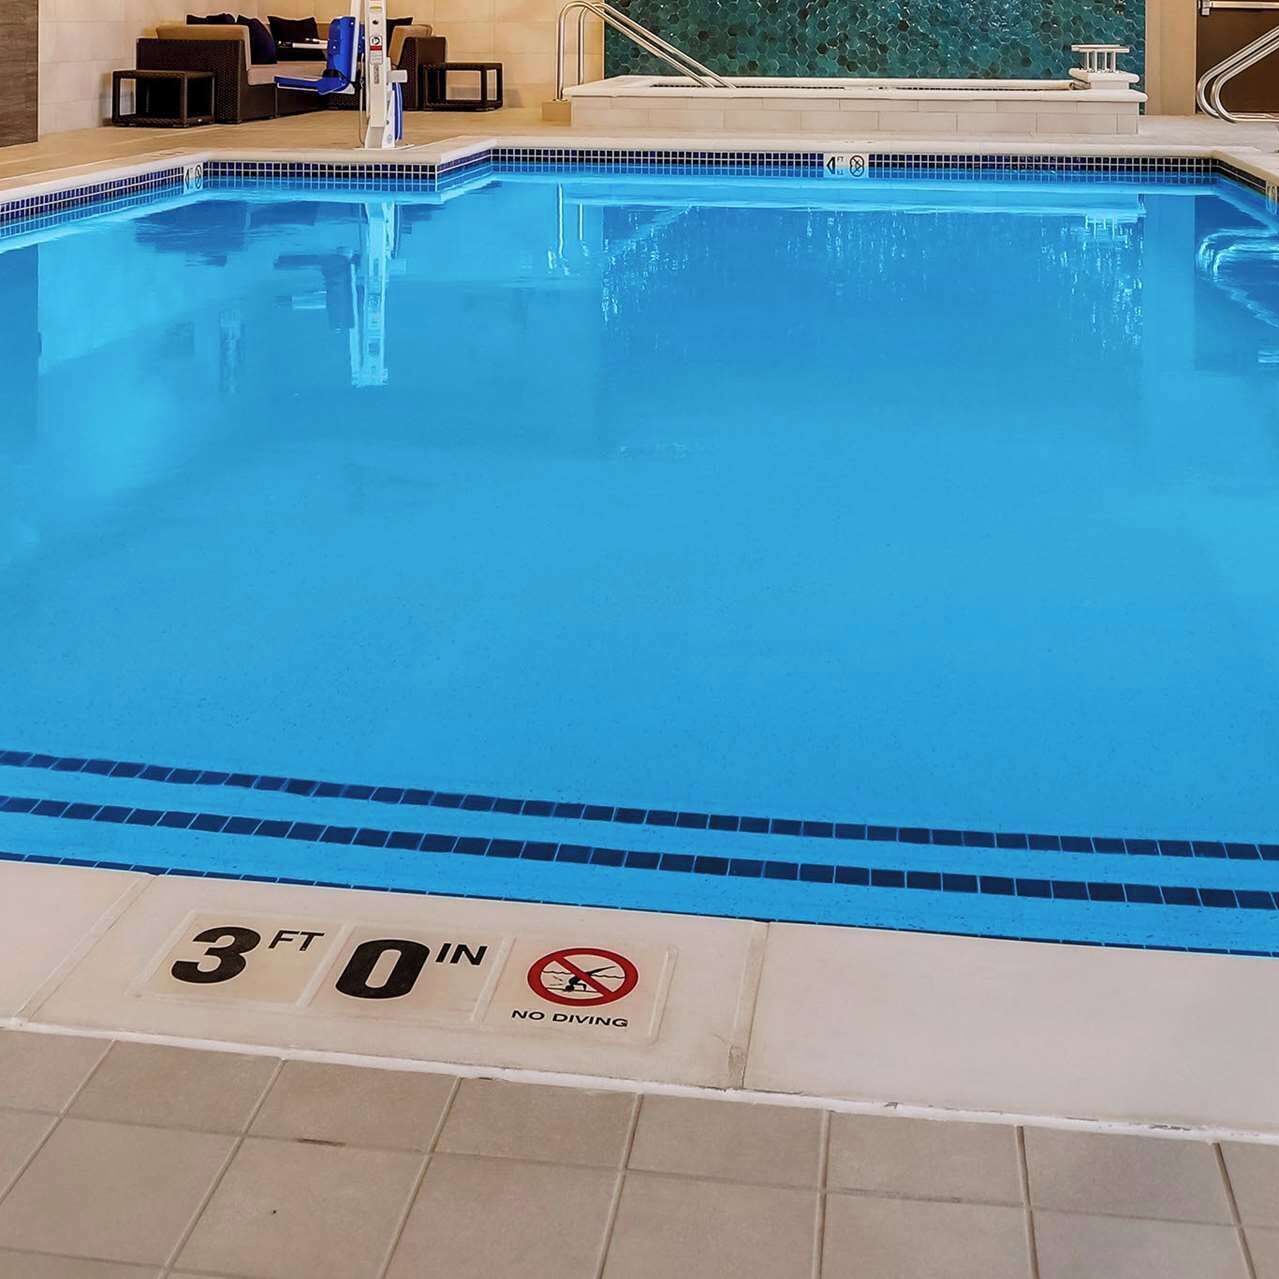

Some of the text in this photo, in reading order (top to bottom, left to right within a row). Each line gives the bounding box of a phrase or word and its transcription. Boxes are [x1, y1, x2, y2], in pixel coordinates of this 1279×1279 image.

[171, 926, 488, 1000] 3 FT 0 IN
[511, 1010, 629, 1028] NO DIVING
